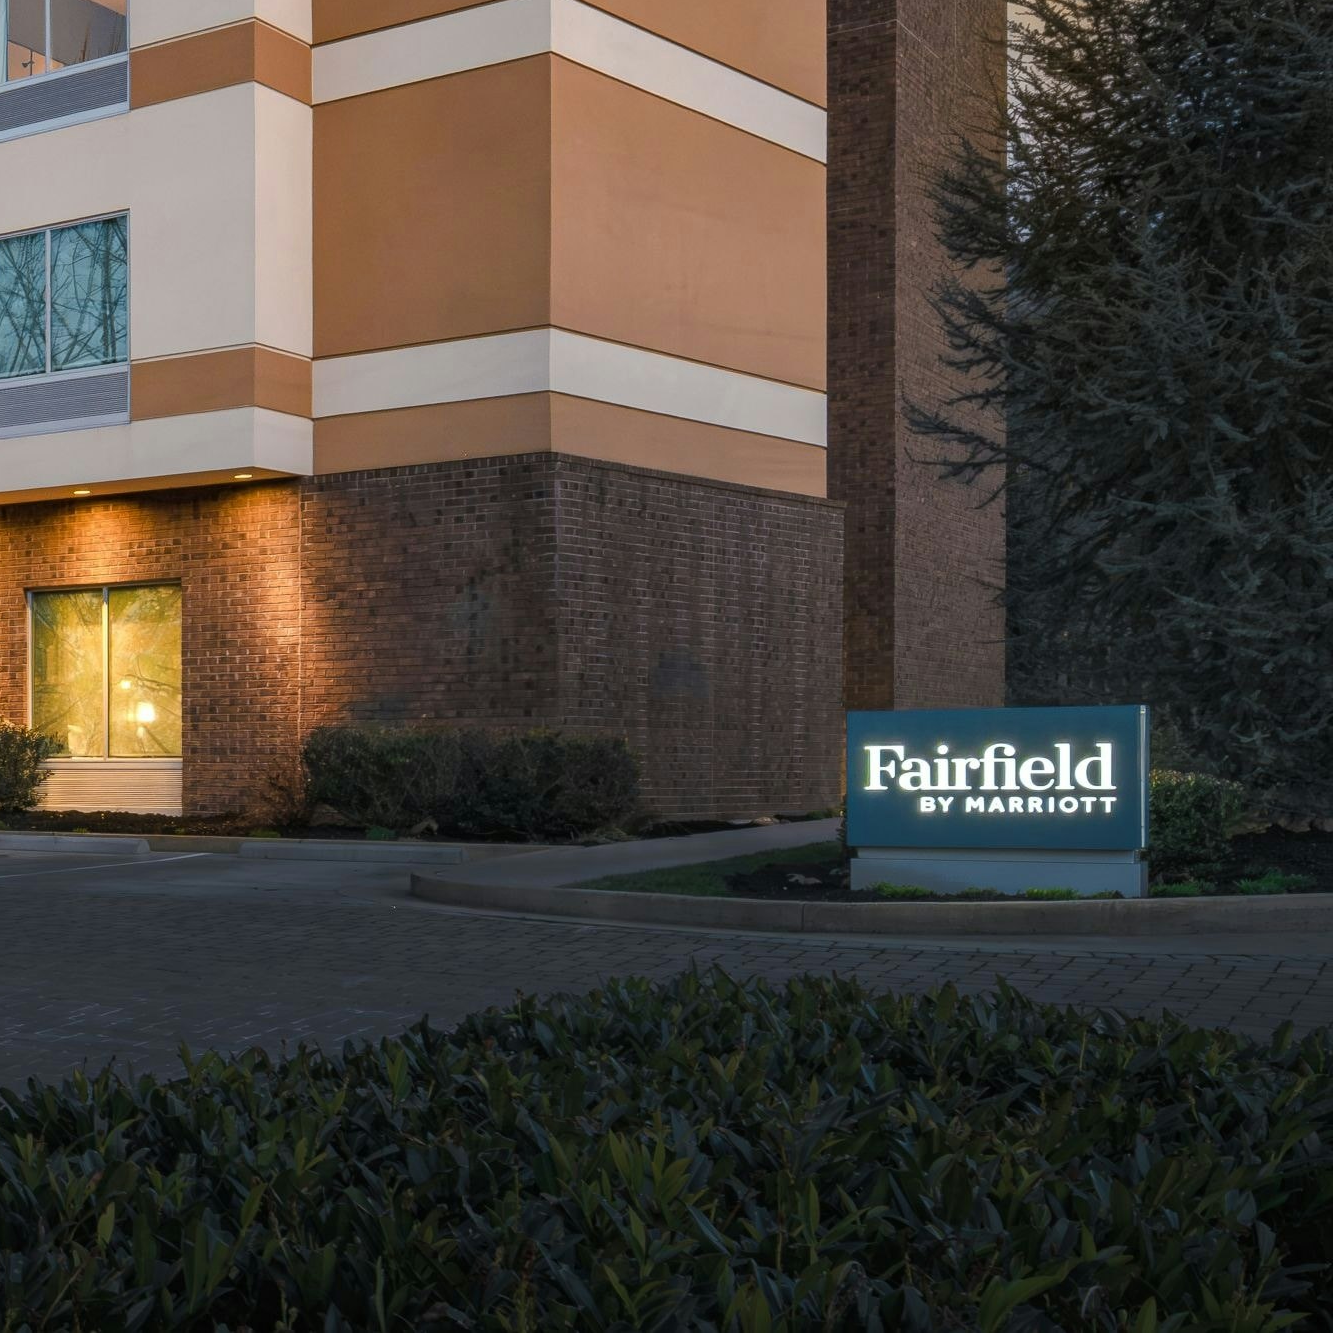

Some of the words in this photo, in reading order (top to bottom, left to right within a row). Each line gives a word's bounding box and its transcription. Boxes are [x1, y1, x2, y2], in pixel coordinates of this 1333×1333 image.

[864, 742, 1117, 791] Fairfield
[920, 797, 954, 813] BY
[966, 797, 1117, 813] MARRIOTT
